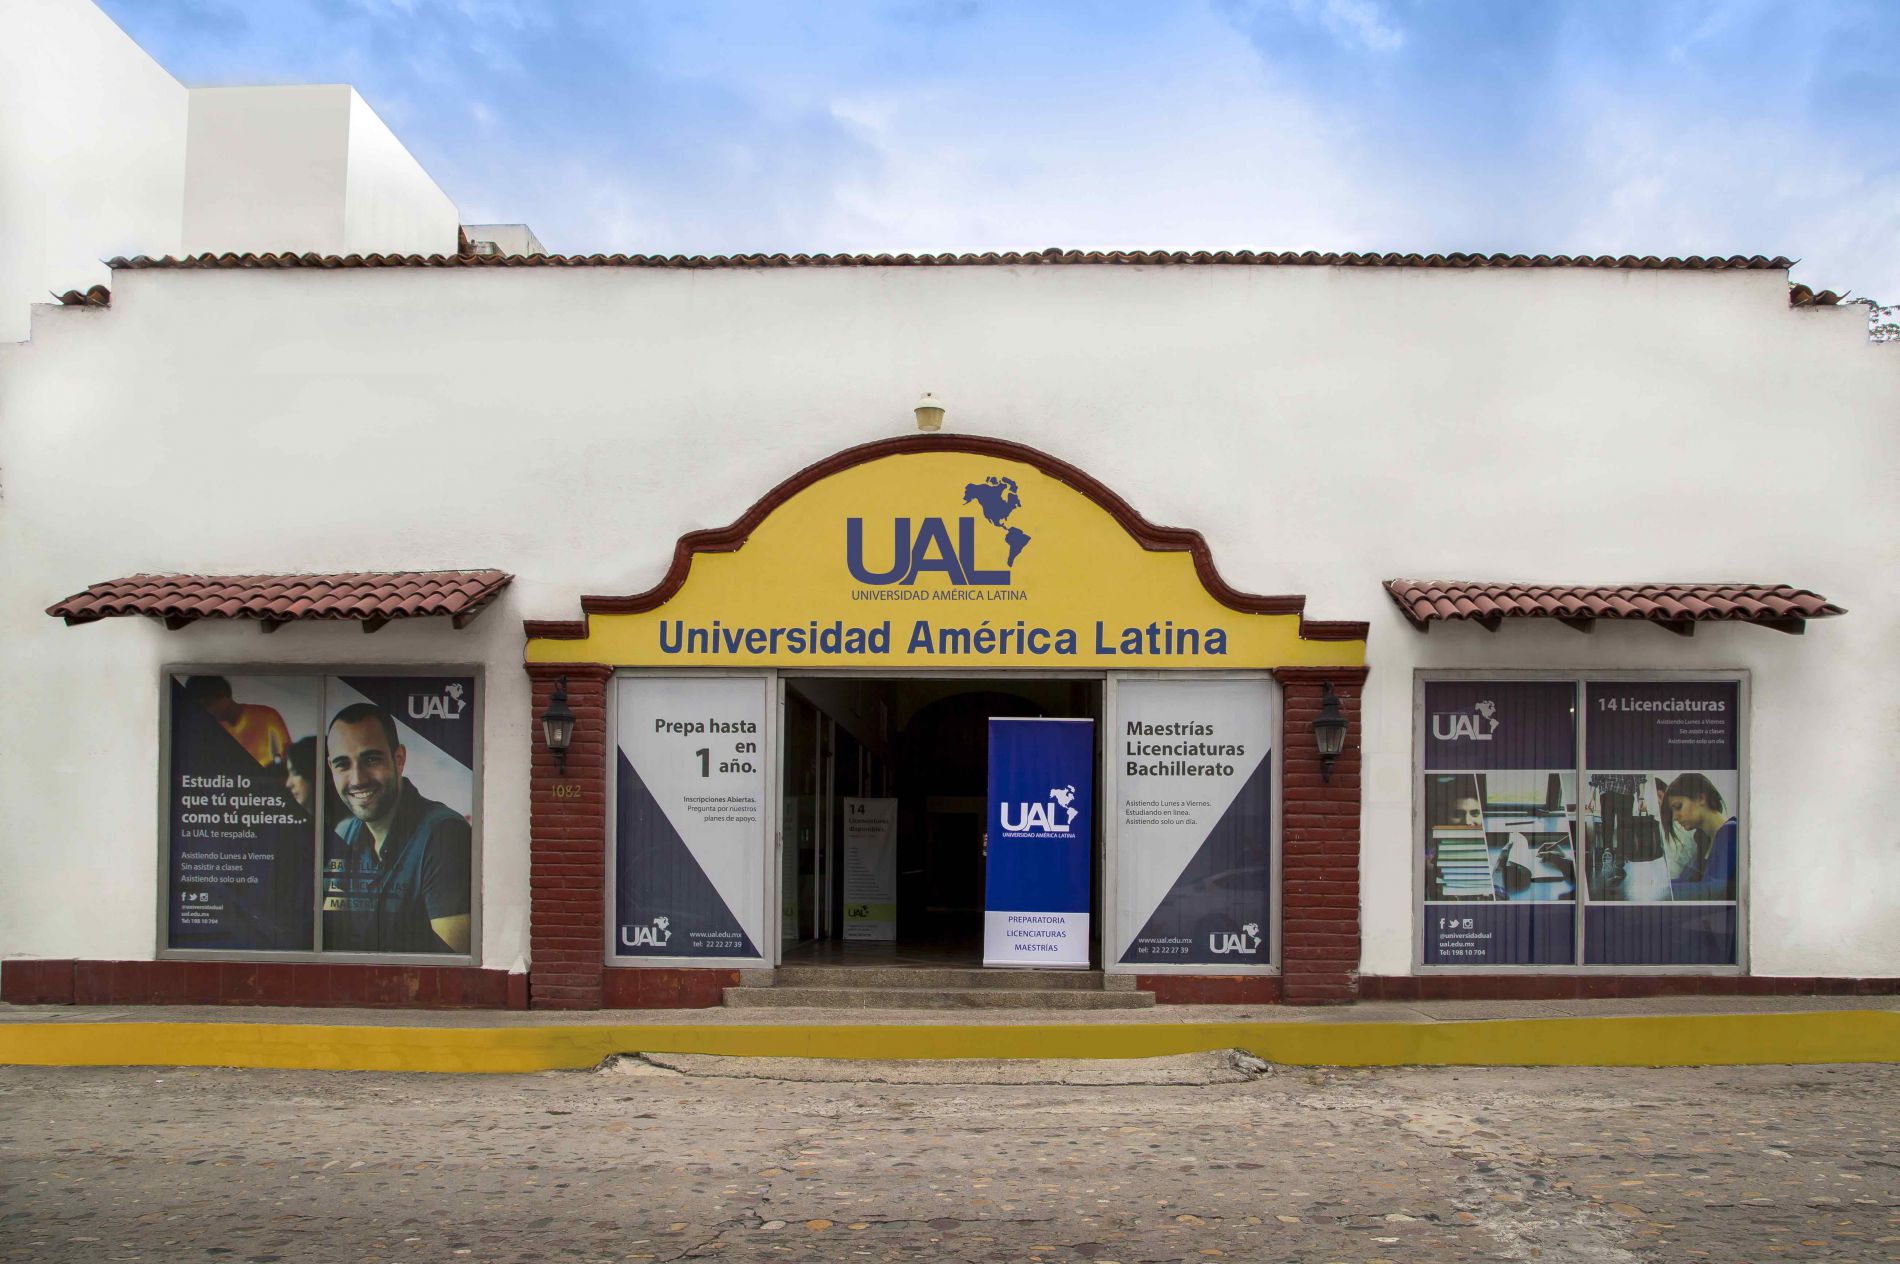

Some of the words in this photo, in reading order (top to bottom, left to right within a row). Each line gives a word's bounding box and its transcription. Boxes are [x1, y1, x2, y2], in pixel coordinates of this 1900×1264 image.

[847, 517, 1011, 585] UAL
[852, 590, 929, 601] UNIVERSIDAD
[933, 588, 984, 601] AMÉRICA
[987, 590, 1028, 601] LATINA
[660, 620, 891, 654] Universidad
[907, 620, 1077, 655] América
[1095, 620, 1228, 655] Latina
[408, 696, 460, 719] UAL
[1599, 698, 1618, 711] 14
[1621, 698, 1726, 712] Licenciaturas
[655, 719, 705, 737] Prepa
[709, 718, 757, 733] hasta
[1126, 721, 1214, 736] Maestrías
[1432, 714, 1493, 740] UAL
[735, 741, 757, 753] en
[1126, 741, 1245, 756] Licenciaturas
[696, 748, 709, 777] 1
[719, 759, 757, 773] año.
[1126, 761, 1234, 776] Bachillerato
[182, 775, 234, 788] Estudia
[238, 775, 251, 788] lo
[552, 785, 581, 797] 1082
[182, 795, 208, 808] que
[212, 793, 227, 806] tú
[230, 793, 287, 809] quieras,
[683, 796, 726, 804] Inscripciones
[687, 805, 716, 813] Pregunta
[182, 813, 220, 823] como
[224, 811, 238, 824] tú
[704, 815, 724, 823] planes
[1000, 802, 1070, 832] UAL
[182, 829, 191, 837] La
[193, 829, 209, 837] UAL
[211, 829, 219, 838] te
[221, 830, 257, 840] respalda.
[181, 852, 218, 860] Asistiendo
[180, 875, 218, 883] Asistiendo
[1008, 916, 1066, 924] PREPARATORIA
[622, 927, 667, 947] UAL
[1006, 930, 1067, 938] LICENCIATURAS
[1014, 943, 1058, 951] MAESTRÍAS
[1210, 934, 1256, 954] UAL
